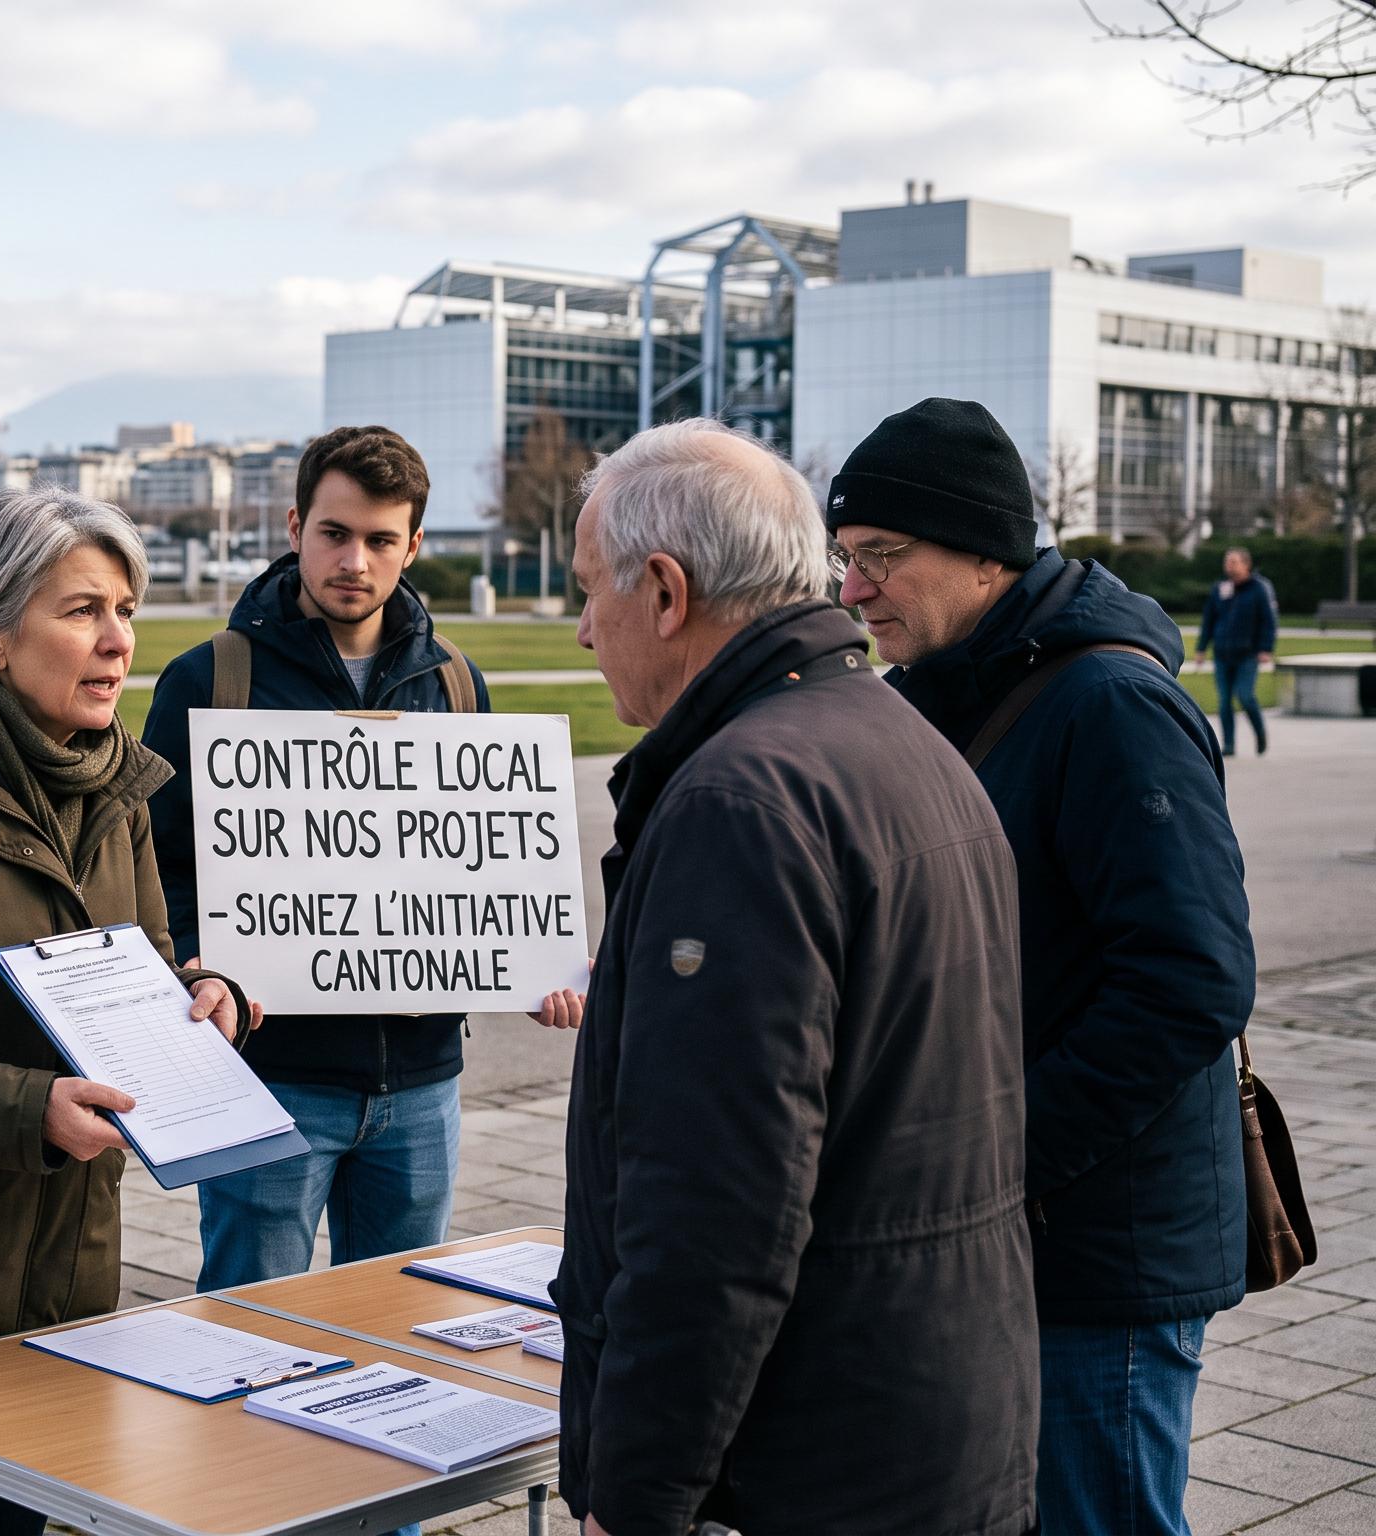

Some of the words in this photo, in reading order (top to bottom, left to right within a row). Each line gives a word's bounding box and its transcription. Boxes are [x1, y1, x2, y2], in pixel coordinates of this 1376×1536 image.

[207, 726, 418, 791] CONTRÔLE
[435, 741, 557, 793] LOCAL
[212, 808, 289, 858] SUR
[304, 808, 381, 859] NOS
[396, 809, 560, 872] PROJETS
[375, 890, 574, 937] L'INITIATIVE
[311, 949, 512, 992] CANTONALE
